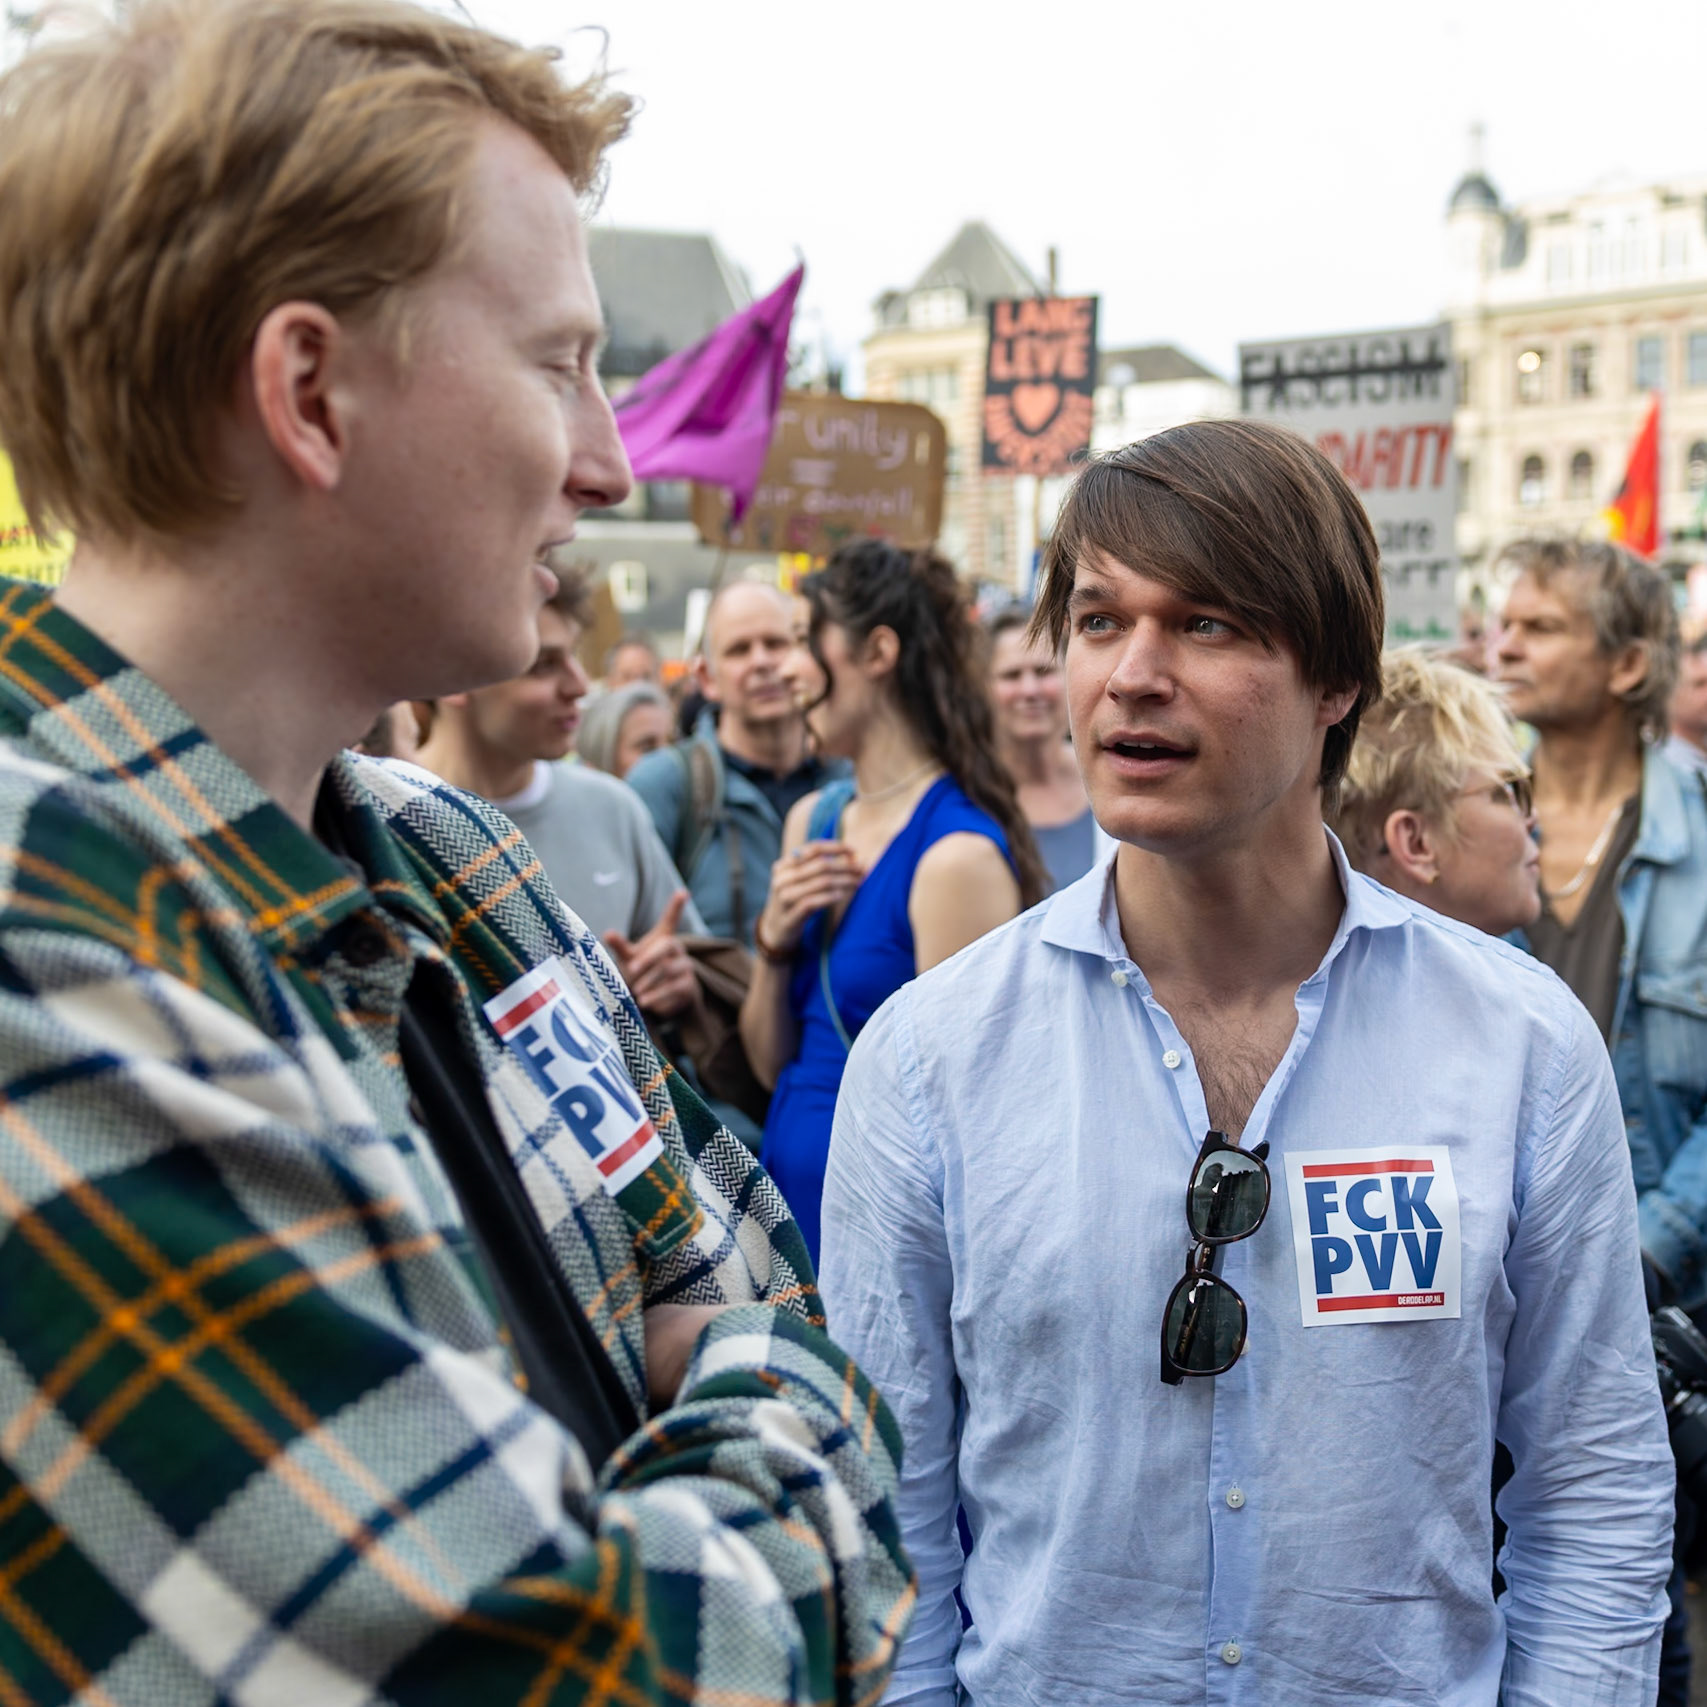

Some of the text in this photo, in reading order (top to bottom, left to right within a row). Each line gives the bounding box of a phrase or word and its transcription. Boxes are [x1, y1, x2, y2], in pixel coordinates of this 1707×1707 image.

[1241, 336, 1442, 411] FASCISM
[1316, 426, 1453, 491] DARITY
[508, 997, 610, 1099] FCK
[1305, 1176, 1443, 1235] FCK
[1311, 1231, 1443, 1294] PVV
